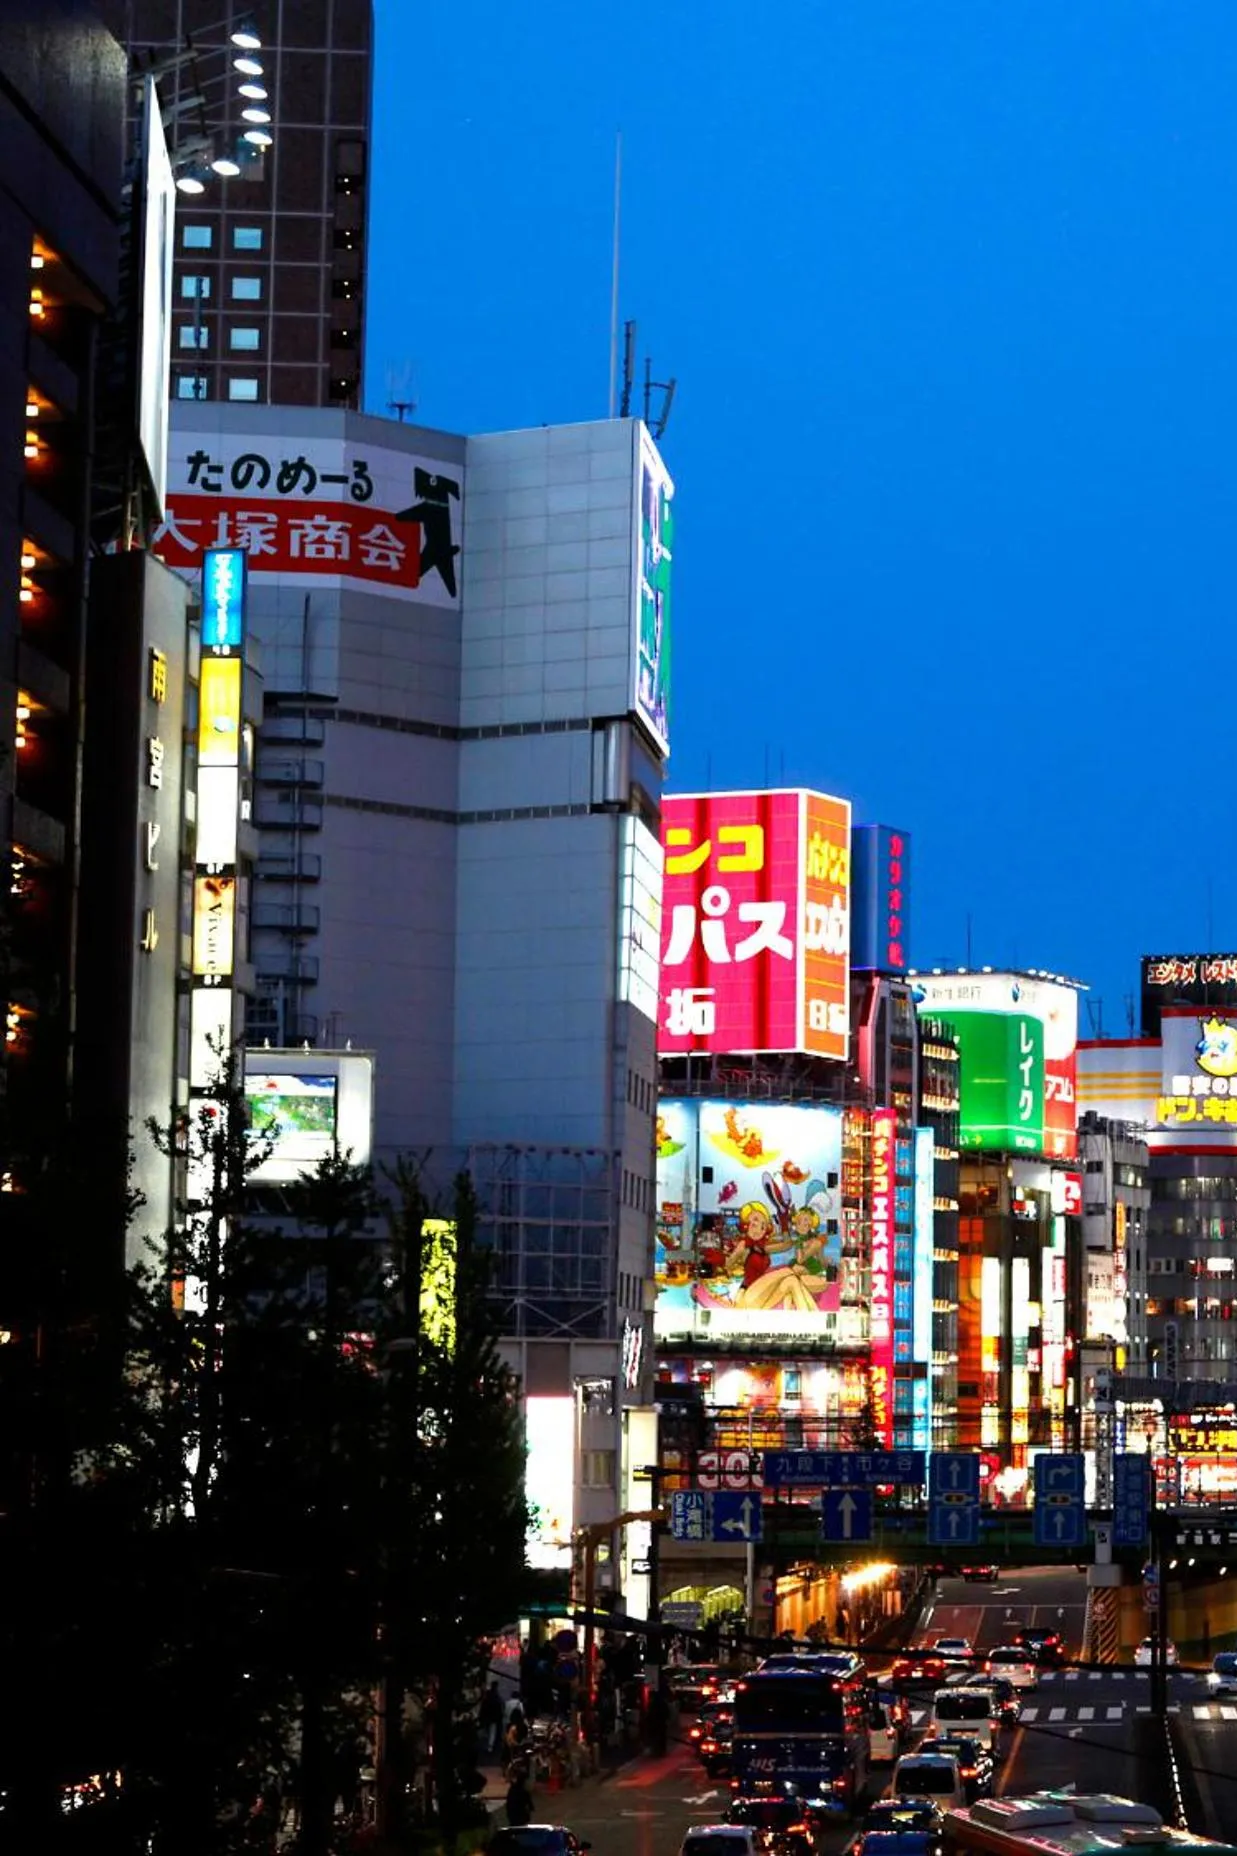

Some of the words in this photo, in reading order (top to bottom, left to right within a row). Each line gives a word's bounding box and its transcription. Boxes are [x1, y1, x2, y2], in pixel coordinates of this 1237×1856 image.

[187, 450, 374, 502] たのめーる
[152, 509, 407, 572] 大塚商会
[1017, 1021, 1035, 1122] レイク
[776, 1455, 834, 1473] 九段下
